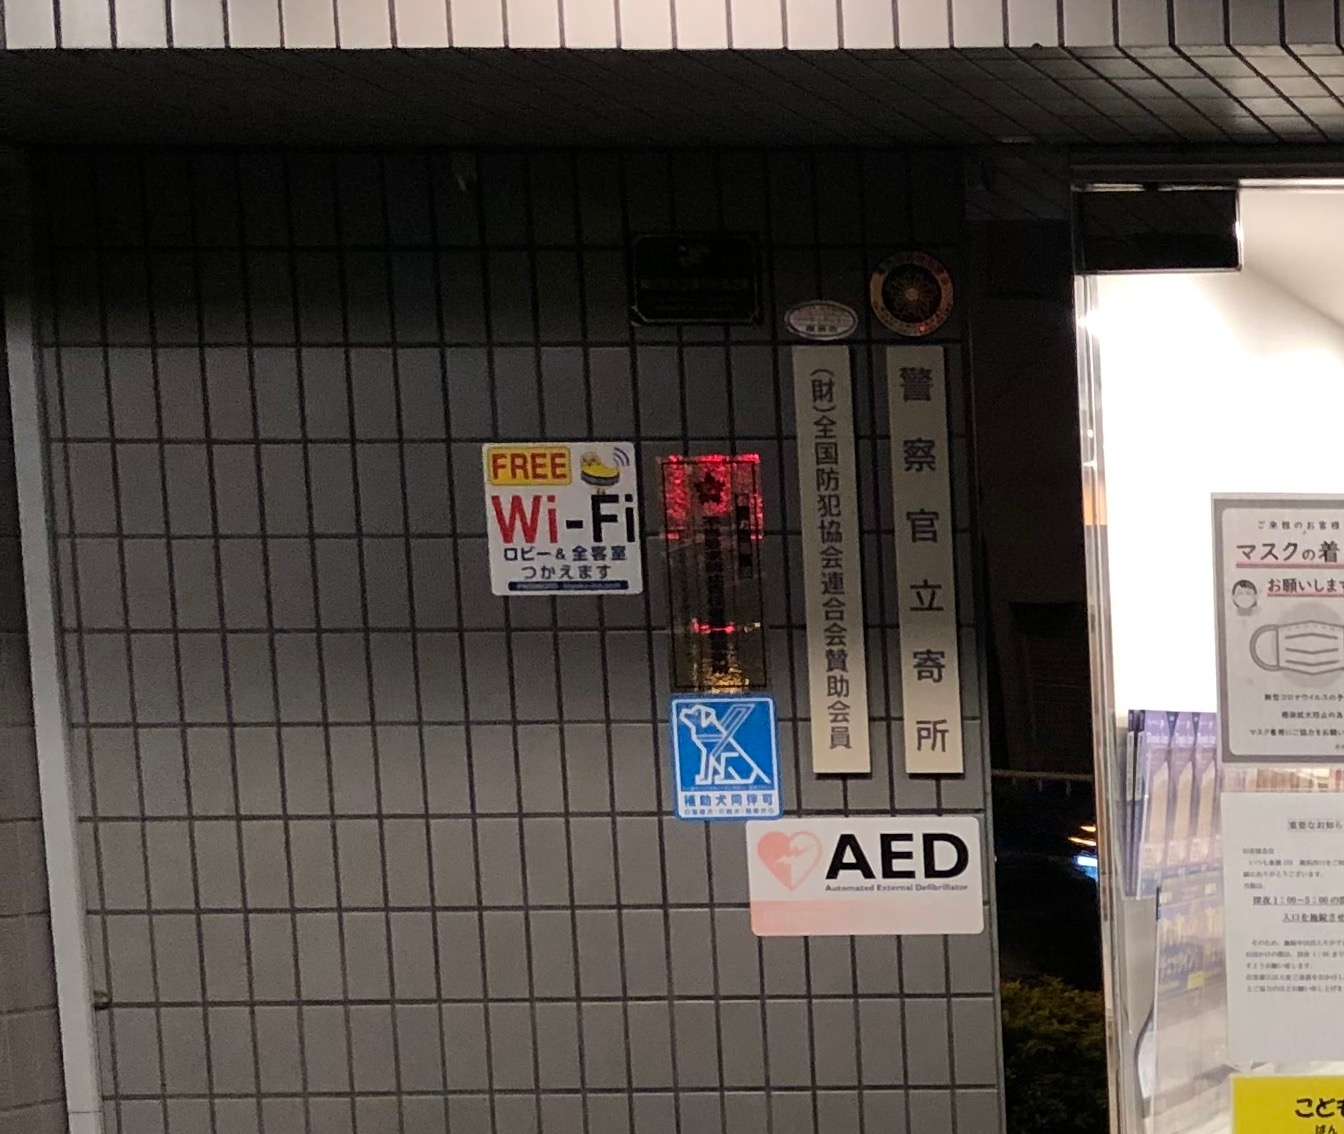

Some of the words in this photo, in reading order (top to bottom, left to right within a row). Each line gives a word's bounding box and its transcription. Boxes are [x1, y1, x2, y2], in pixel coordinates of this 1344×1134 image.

[492, 453, 568, 480] FREE
[490, 494, 636, 544] Wi-Fi
[521, 564, 612, 580] つかえます
[898, 366, 949, 753] 警察官立寄所
[825, 833, 969, 880] AED
[825, 884, 875, 892] Automated
[876, 884, 914, 892] External
[915, 884, 969, 892] Defibrillator
